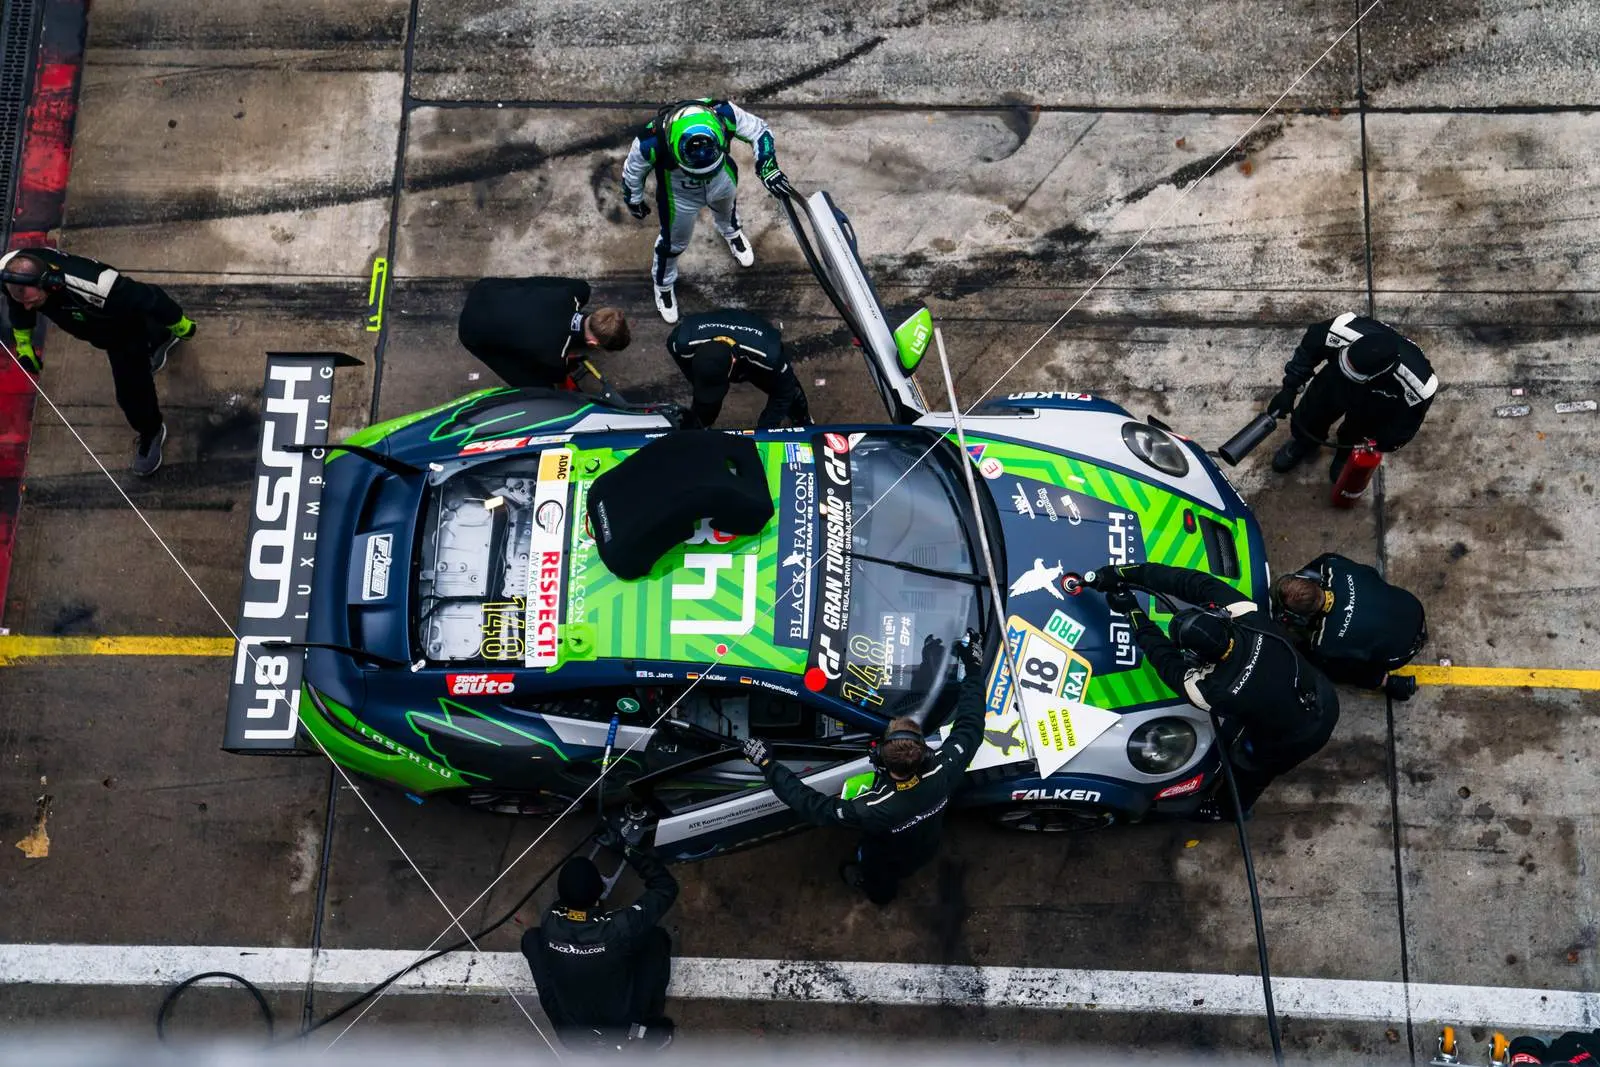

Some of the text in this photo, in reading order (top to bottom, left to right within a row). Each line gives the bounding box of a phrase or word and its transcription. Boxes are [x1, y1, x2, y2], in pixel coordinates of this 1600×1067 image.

[556, 455, 568, 480] ADAC
[243, 366, 312, 619] LOSCH
[295, 366, 334, 619] LUXEMBOURG
[794, 472, 807, 548] FALCON
[531, 552, 540, 566] MY
[530, 569, 538, 594] RACE
[575, 554, 588, 623] FALCON
[537, 551, 560, 658] RESPECT!
[790, 572, 805, 638] BLACK
[823, 576, 842, 631] GRAN
[842, 588, 850, 611] REAL
[1338, 574, 1356, 638] BLACK FALCON
[480, 595, 525, 659] 148
[528, 609, 536, 632] FAIR
[1049, 616, 1081, 645] PRO
[526, 636, 535, 658] PLAY
[706, 673, 727, 681] Müller
[843, 635, 885, 705] 148
[1232, 633, 1263, 695] BLACK FALCON
[453, 680, 515, 694] auto
[455, 674, 488, 684] sport
[1038, 720, 1049, 746] CHECK
[1049, 710, 1063, 751] FUEL RESET
[1064, 719, 1075, 747] DRIVER
[360, 727, 452, 779] LOSCH.LU
[1011, 789, 1101, 802] FALKEN
[892, 820, 916, 833] BLACK
[549, 941, 605, 955] BLACK FALCON
